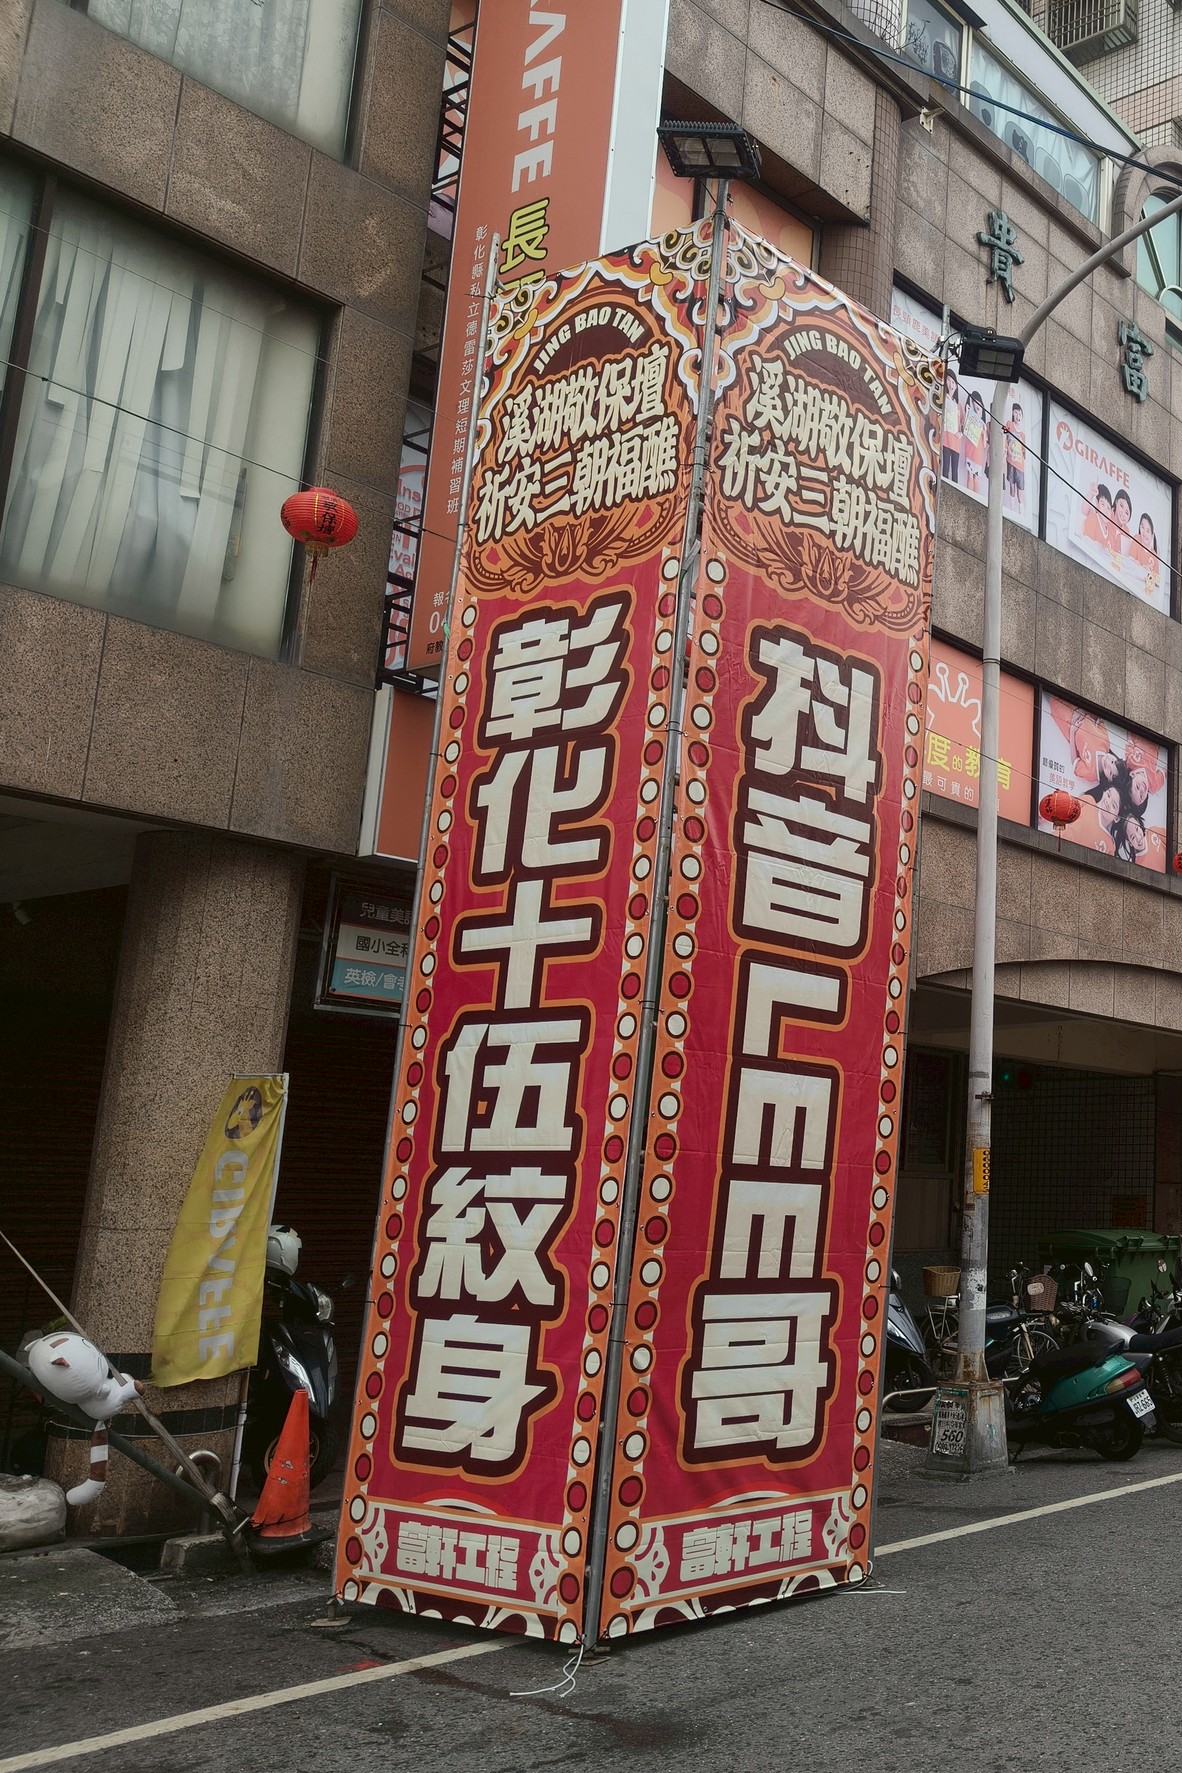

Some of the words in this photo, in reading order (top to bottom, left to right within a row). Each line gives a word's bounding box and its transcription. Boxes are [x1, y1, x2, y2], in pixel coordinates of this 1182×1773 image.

[511, 0, 566, 194] AFFE
[447, 224, 488, 515] 彰化縣私立德雷莎文理短期補習班
[498, 343, 669, 463] 溪湖敬保壇
[533, 329, 572, 375] JING
[575, 306, 610, 328] BAO
[613, 307, 645, 343] TAN
[783, 330, 823, 361] JING
[826, 332, 861, 370] BAO
[863, 369, 892, 415] TAN
[473, 416, 678, 543] 祈安三朝福醮
[718, 417, 919, 587] 祈安三朝福醮
[746, 354, 912, 511] 溪湖敬保壇
[1074, 439, 1130, 489] GIRAFFE
[401, 603, 628, 1461] 彰化十伍紋身
